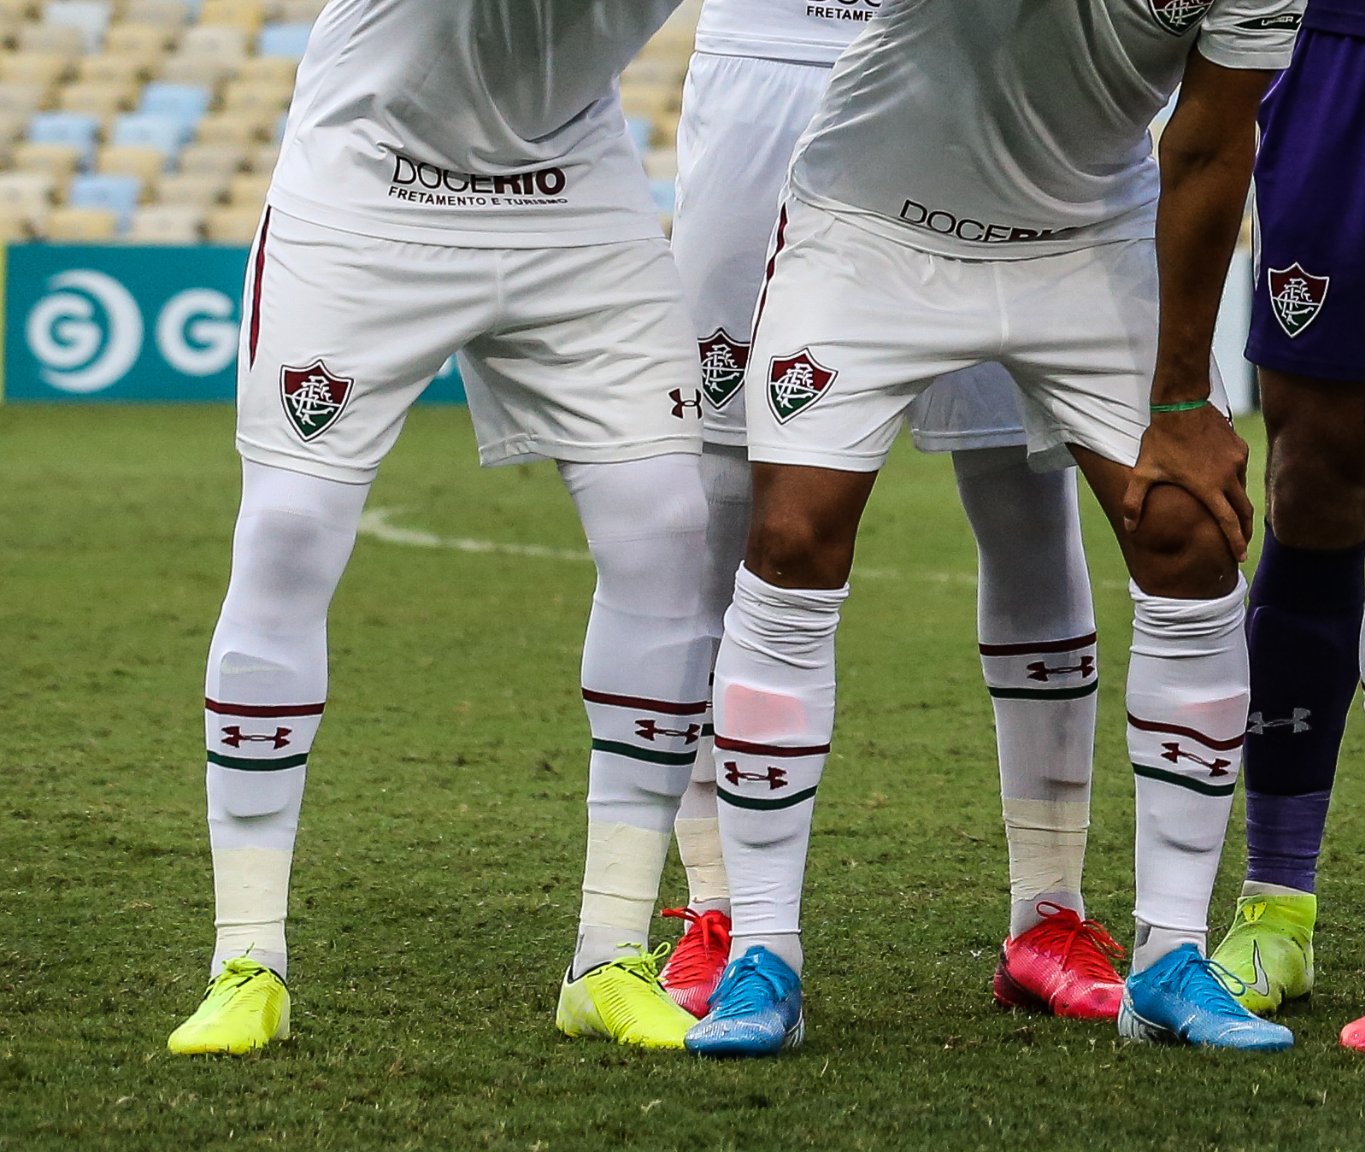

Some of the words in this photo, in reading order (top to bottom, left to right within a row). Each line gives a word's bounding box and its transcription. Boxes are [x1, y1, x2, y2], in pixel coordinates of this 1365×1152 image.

[806, 5, 873, 22] FRETAME
[392, 155, 567, 196] DOCERIO
[388, 185, 487, 206] FRETAMENTO
[491, 197, 501, 206] E
[502, 197, 569, 206] TURISMO
[899, 199, 1058, 243] DOCE
